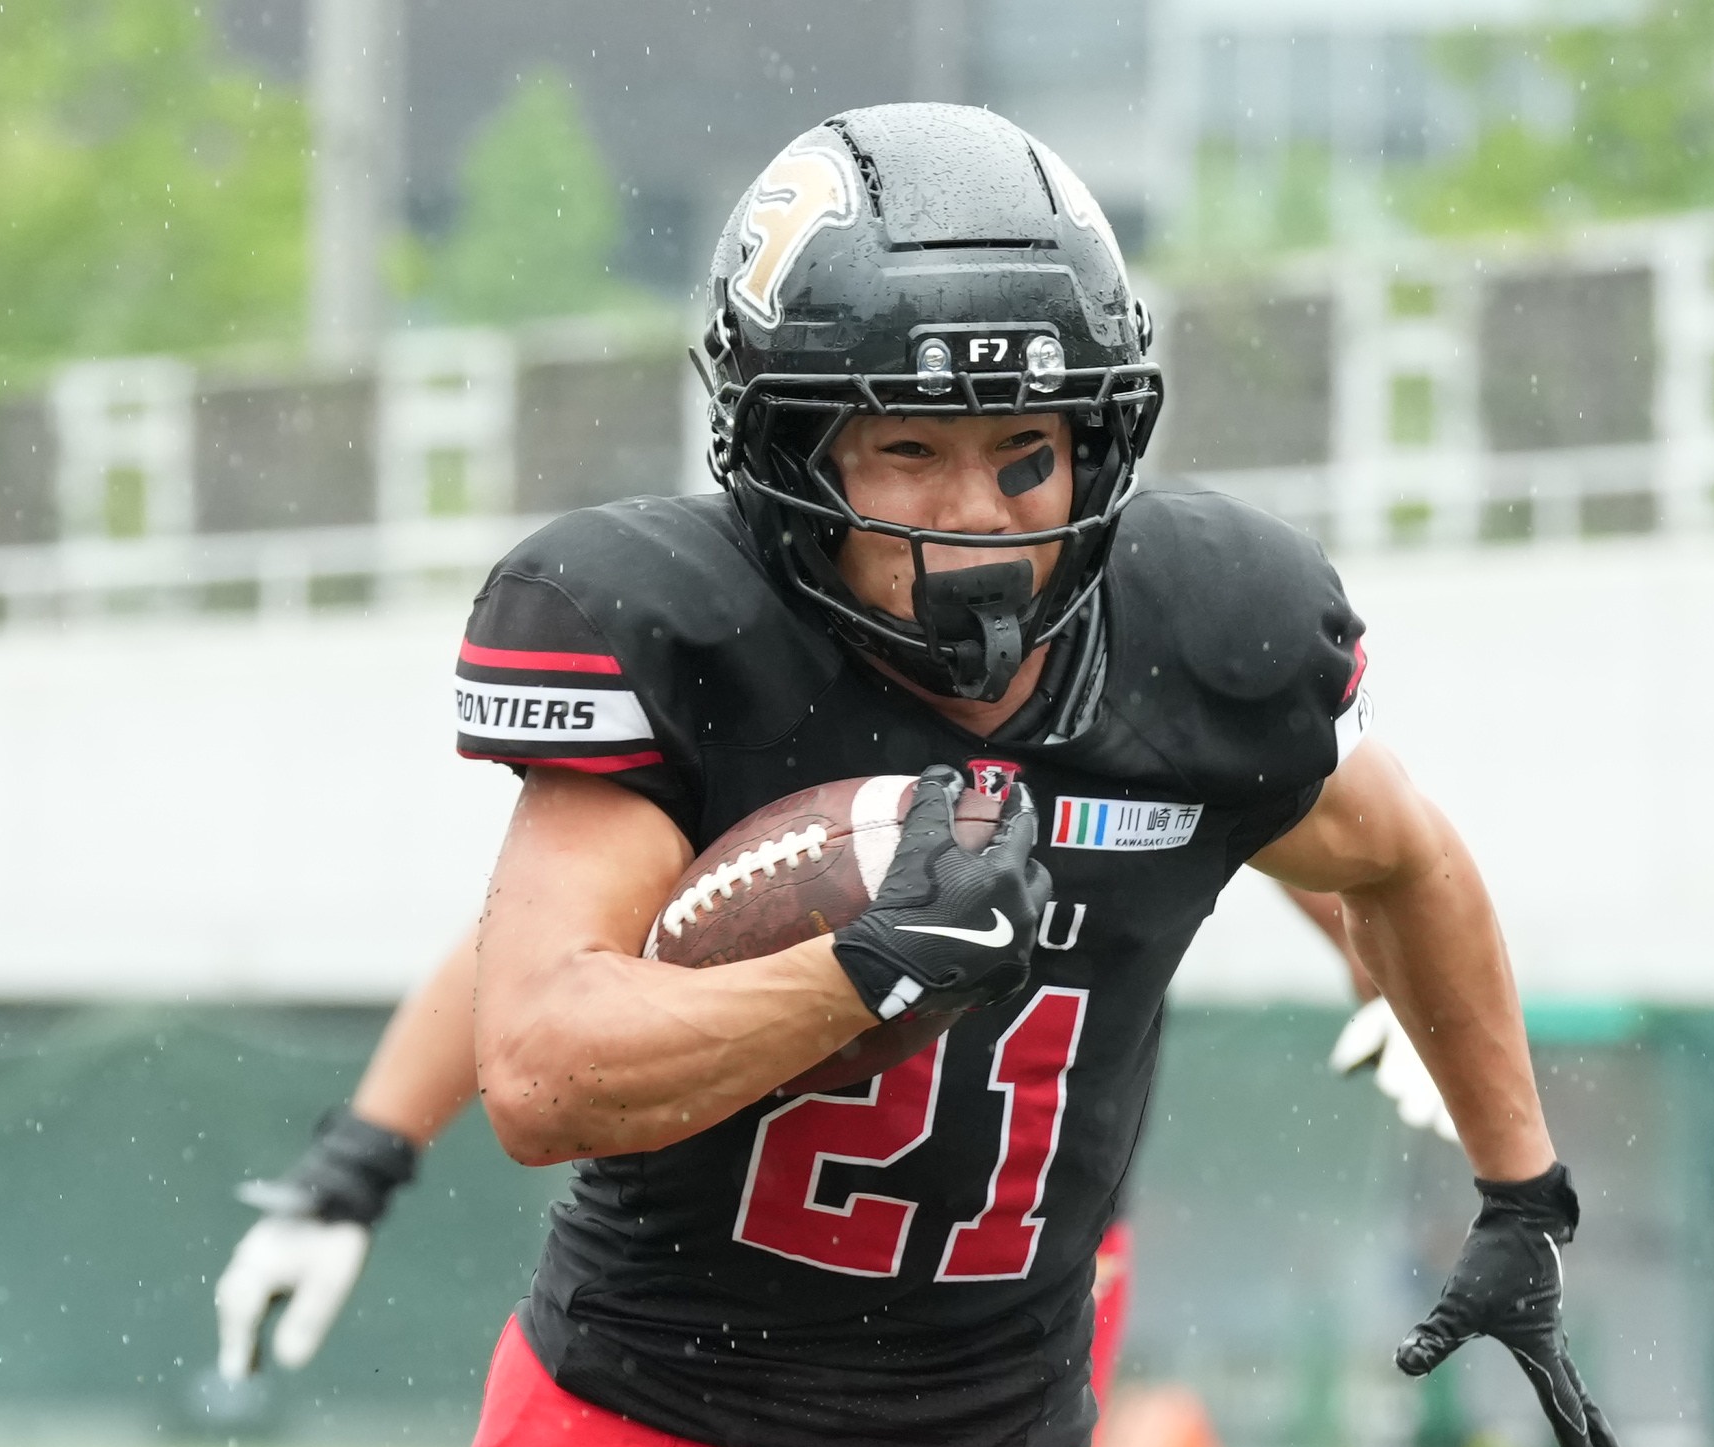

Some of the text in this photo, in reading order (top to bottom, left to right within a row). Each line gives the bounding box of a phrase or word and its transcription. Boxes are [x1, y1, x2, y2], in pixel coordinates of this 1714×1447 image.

[969, 338, 1009, 363] F7
[455, 688, 596, 730] RONTIERS
[1117, 806, 1198, 832] 川崎市
[1114, 835, 1188, 848] KAWASAKI CITY
[733, 985, 1090, 1283] 21
